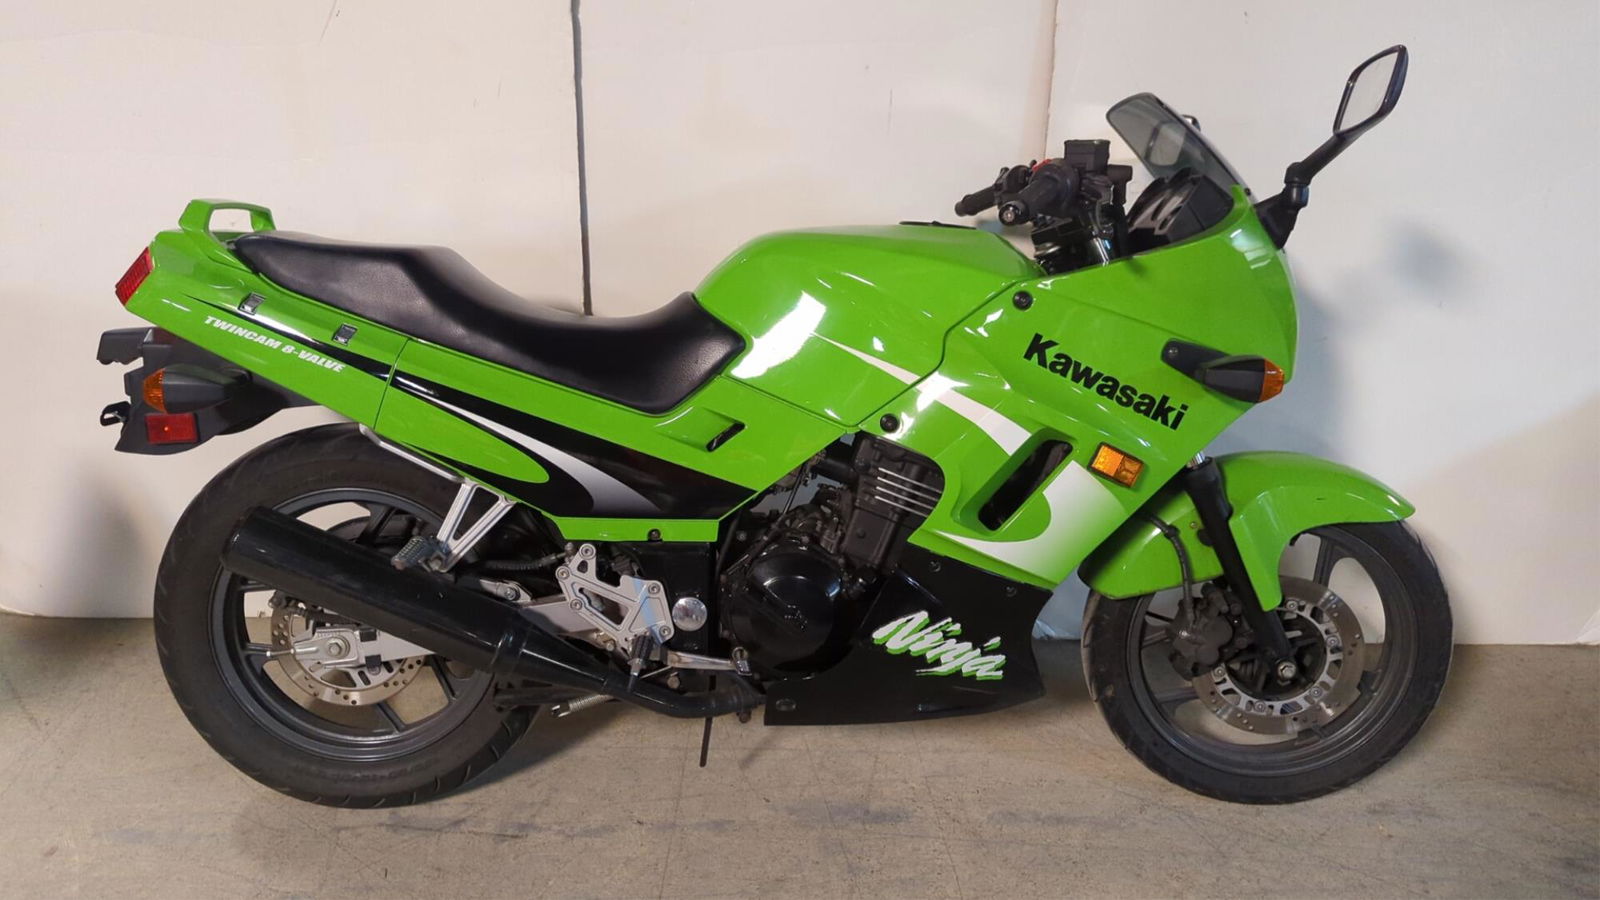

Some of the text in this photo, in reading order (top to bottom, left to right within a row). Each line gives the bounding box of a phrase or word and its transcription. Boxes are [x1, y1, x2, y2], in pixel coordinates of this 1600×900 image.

[204, 316, 345, 372] TWINCAM 8-VALVE
[1023, 333, 1188, 430] Kawasaki
[872, 610, 1006, 680] Ninja
